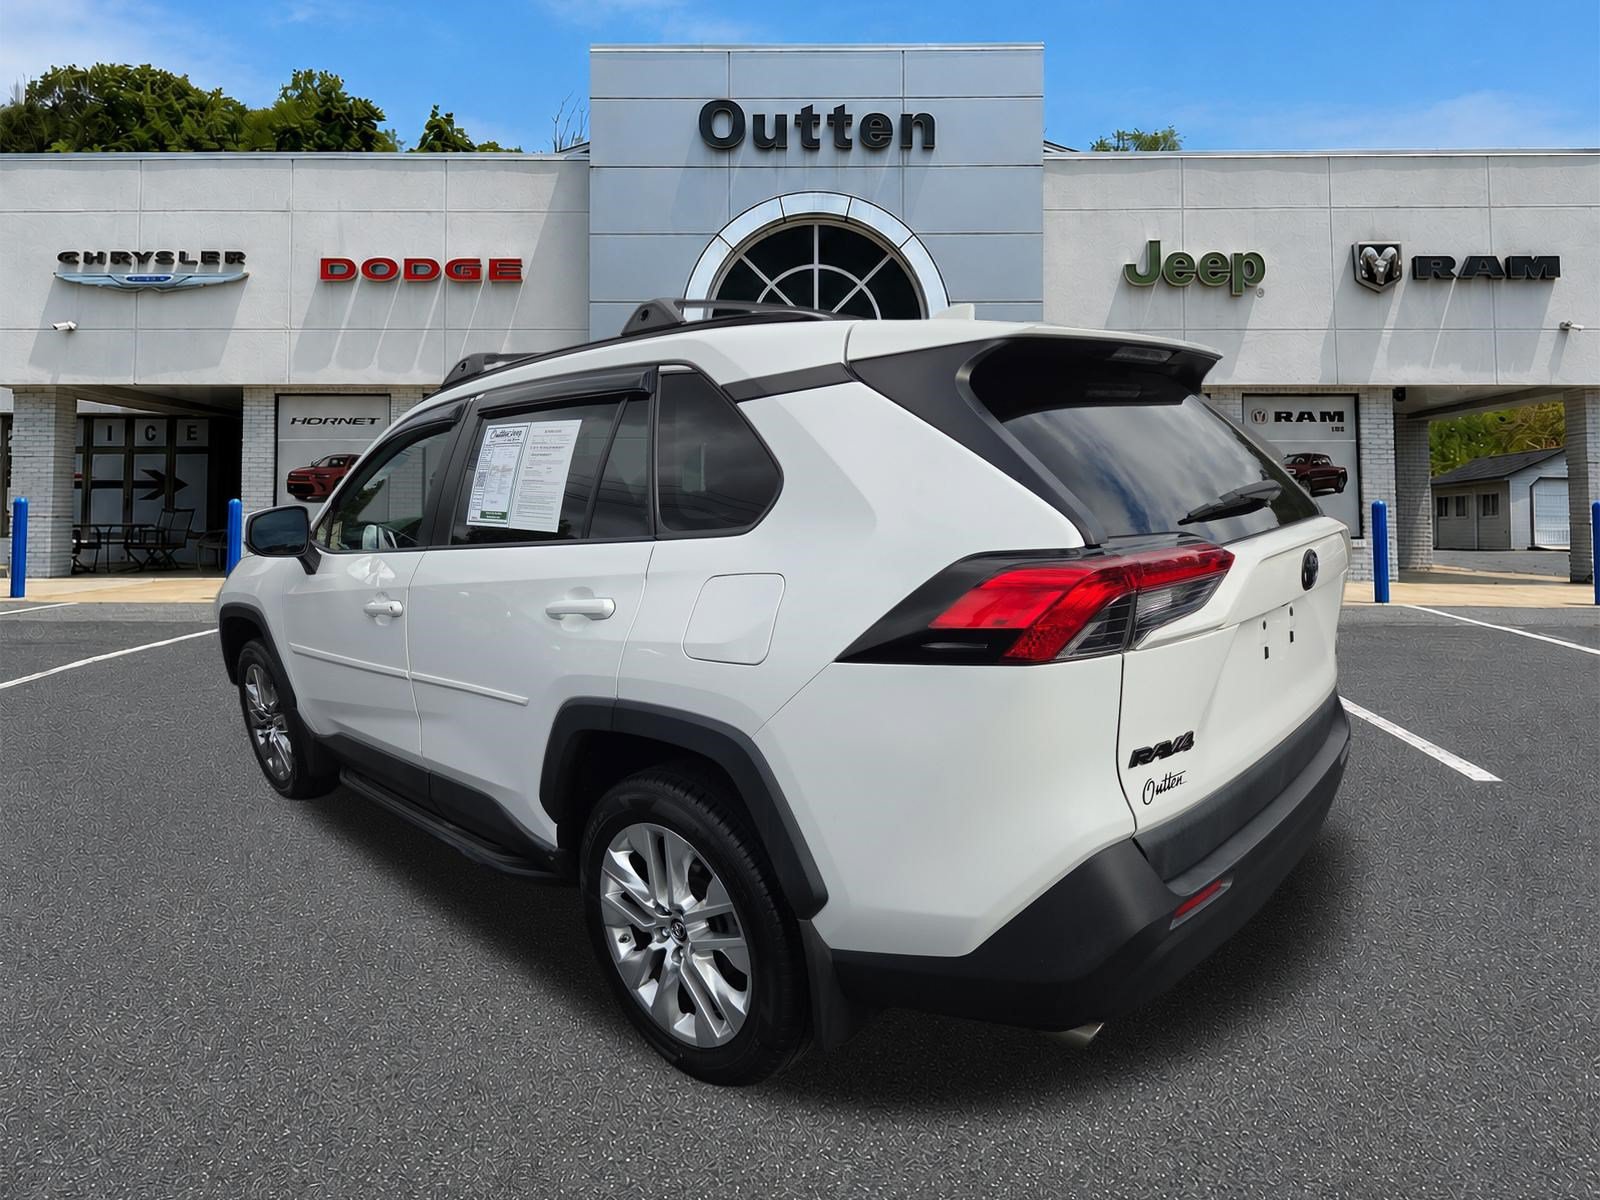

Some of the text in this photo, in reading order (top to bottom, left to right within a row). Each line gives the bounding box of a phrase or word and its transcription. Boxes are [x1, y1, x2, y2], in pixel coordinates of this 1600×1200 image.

[699, 99, 936, 149] Outten
[57, 251, 247, 265] CHRYSLER
[320, 257, 523, 282] DODGE
[1123, 240, 1266, 296] Jeep
[1411, 256, 1561, 280] RAM
[290, 417, 381, 426] HORNET
[1274, 411, 1345, 423] RAM
[1128, 730, 1194, 769] RAV4
[1142, 770, 1188, 805] Outten
